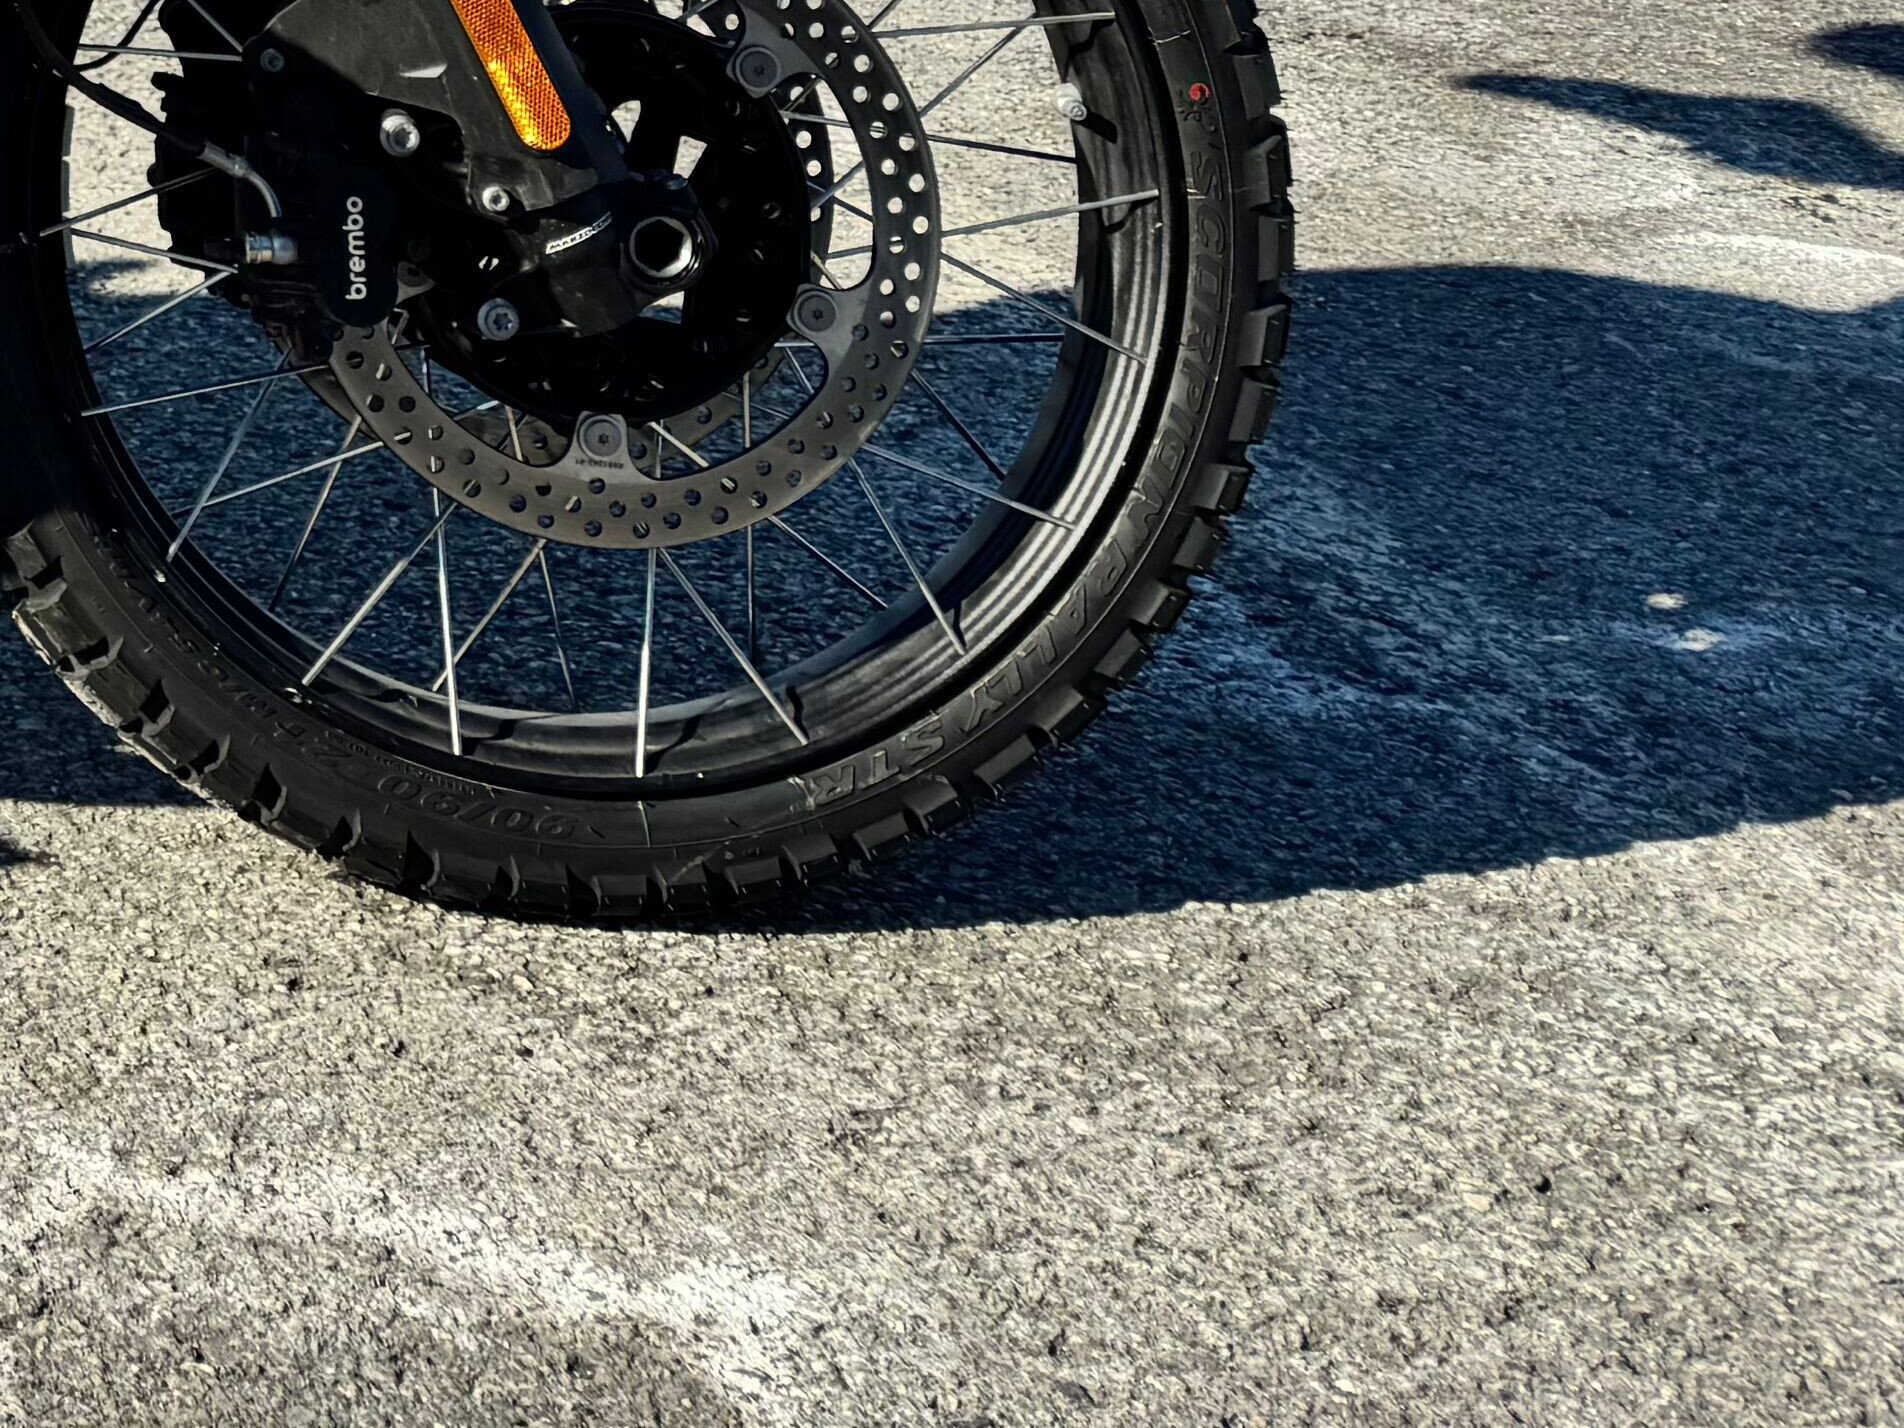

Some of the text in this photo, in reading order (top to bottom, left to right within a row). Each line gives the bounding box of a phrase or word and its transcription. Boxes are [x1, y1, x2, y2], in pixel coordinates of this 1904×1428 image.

[342, 196, 367, 300] brembo
[811, 149, 1226, 807] SCORPION RALLY STR
[376, 775, 584, 841] 90/90
